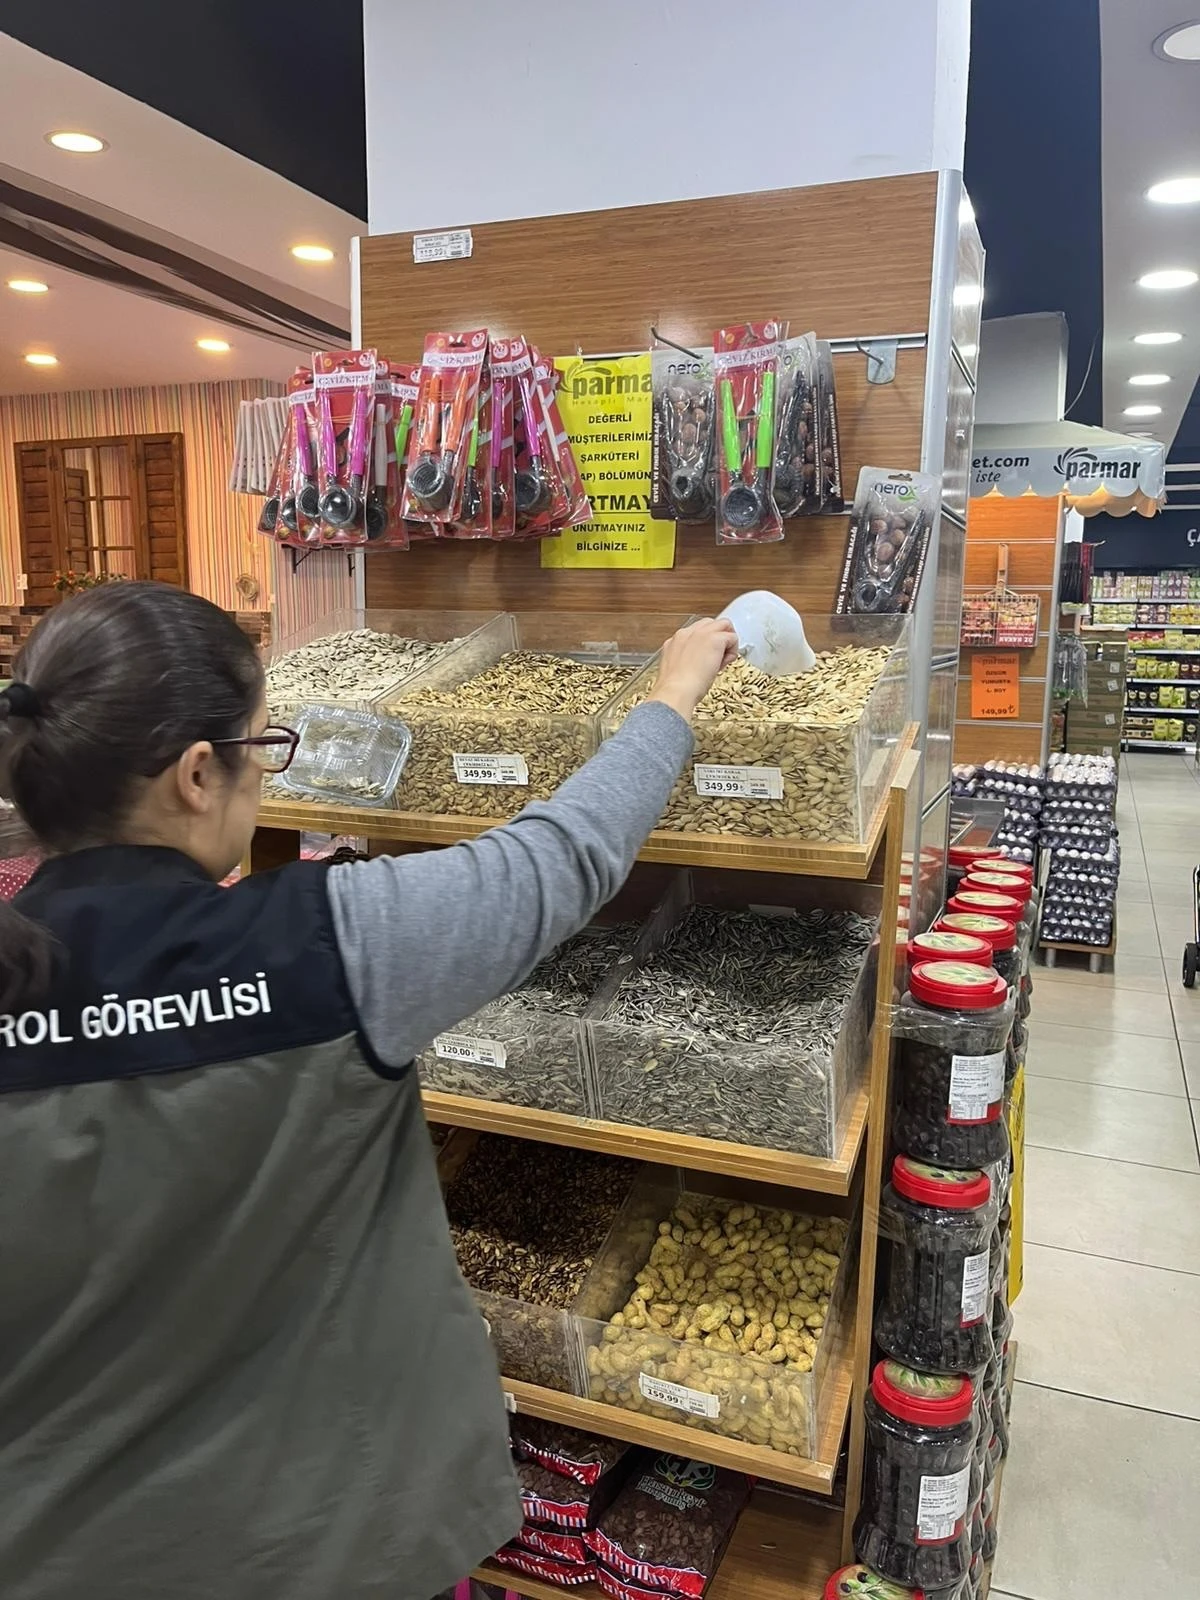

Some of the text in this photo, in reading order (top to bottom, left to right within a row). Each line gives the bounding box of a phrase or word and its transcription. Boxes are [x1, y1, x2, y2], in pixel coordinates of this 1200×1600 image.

[667, 361, 710, 375] nerox
[588, 414, 633, 425] DEĞERLİ
[580, 451, 640, 463] ŞARKÜTERİ
[1065, 460, 1142, 480] parmar
[874, 482, 917, 497] nerox
[572, 523, 646, 533] UNUTMAYINIZ
[1187, 529, 1200, 547] Ç
[576, 541, 628, 552] BİLGİNİZE
[0, 972, 272, 1047] ROL GÖREVLİSİ
